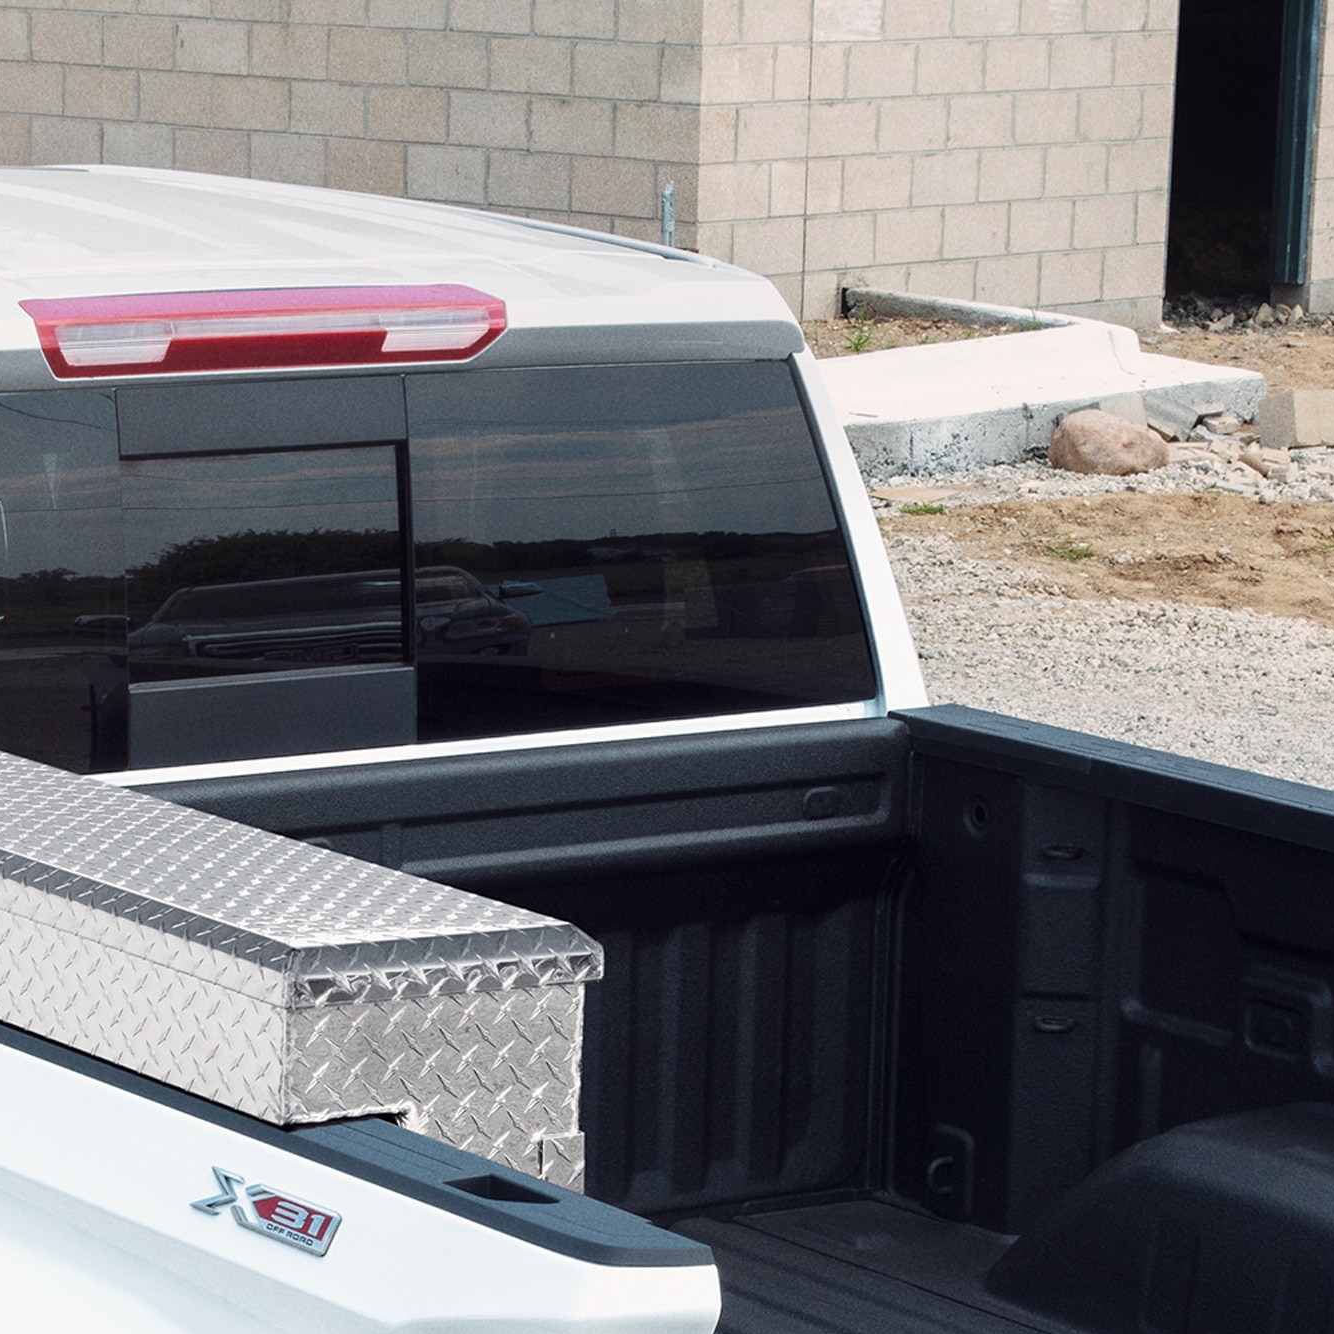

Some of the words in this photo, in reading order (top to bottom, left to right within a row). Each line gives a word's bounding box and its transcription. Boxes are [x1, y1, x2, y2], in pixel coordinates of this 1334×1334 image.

[189, 1165, 327, 1240] X31
[266, 1222, 285, 1236] OFF
[286, 1229, 315, 1247] ROAD
